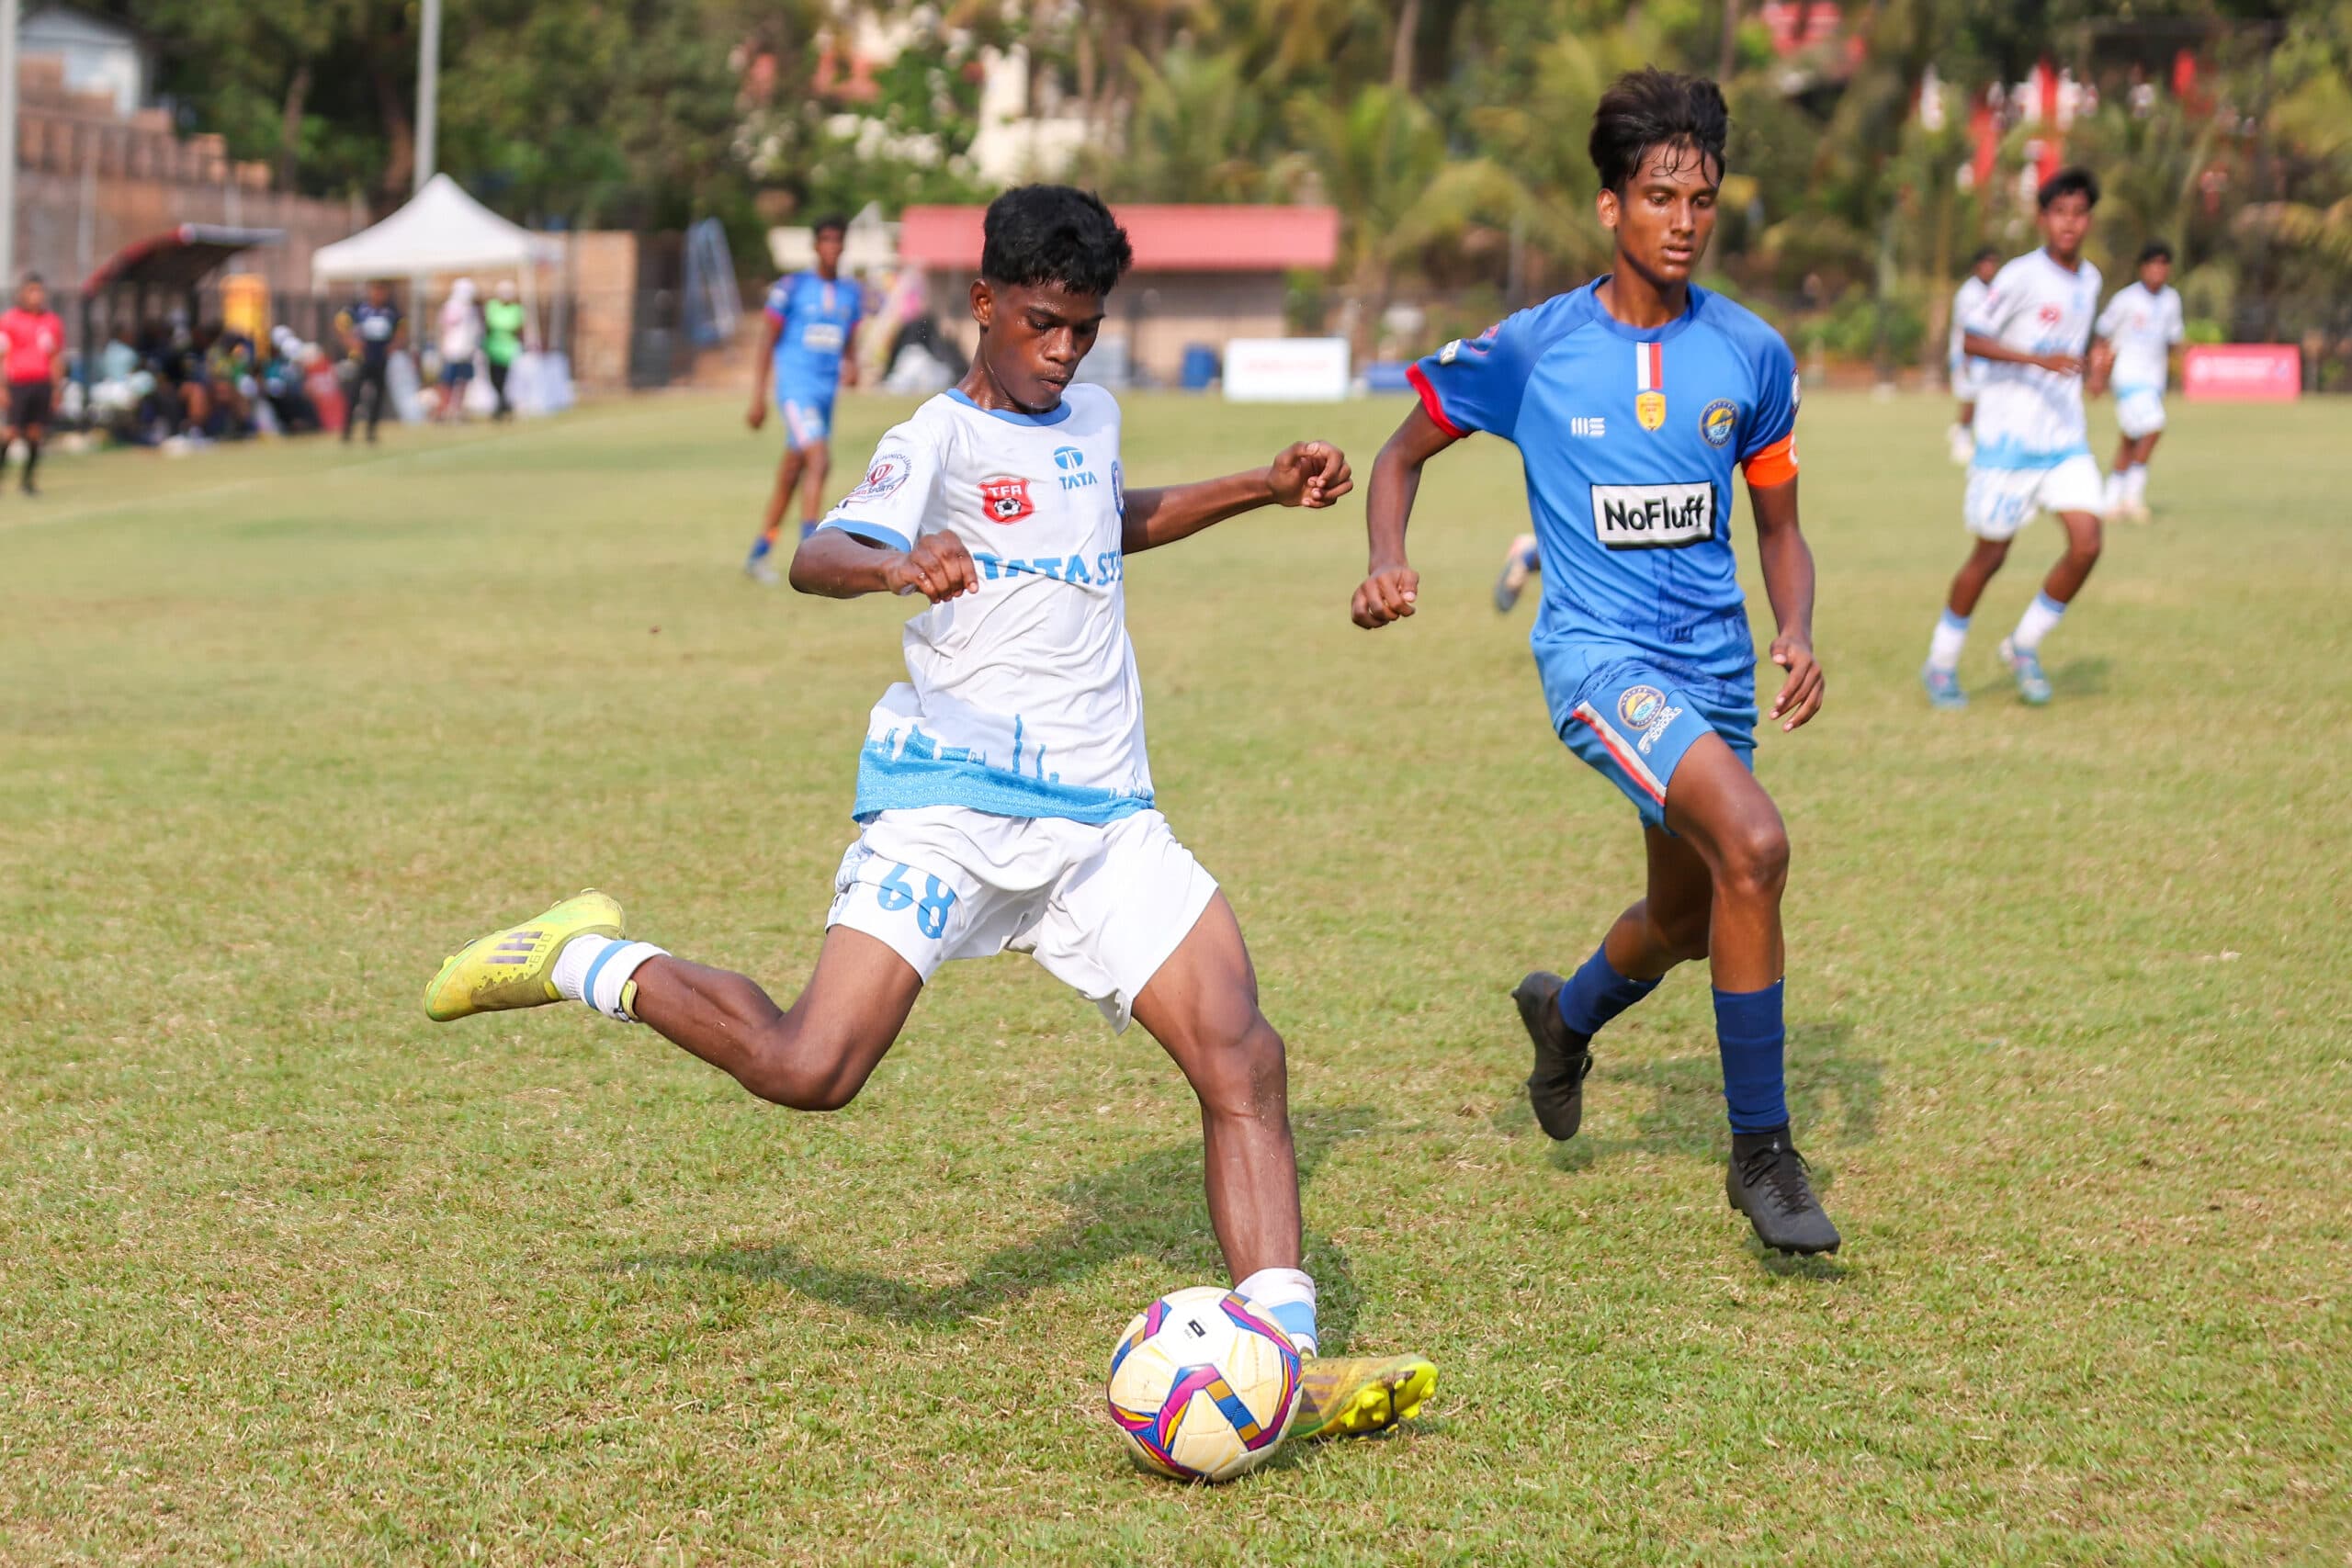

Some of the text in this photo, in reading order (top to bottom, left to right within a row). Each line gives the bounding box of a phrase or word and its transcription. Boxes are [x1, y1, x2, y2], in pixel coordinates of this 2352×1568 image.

[988, 485, 1023, 497] TFA
[1058, 470, 1098, 491] TATA
[1602, 493, 1704, 531] NoFluff
[973, 552, 1091, 584] TATA
[876, 862, 957, 939] 68
